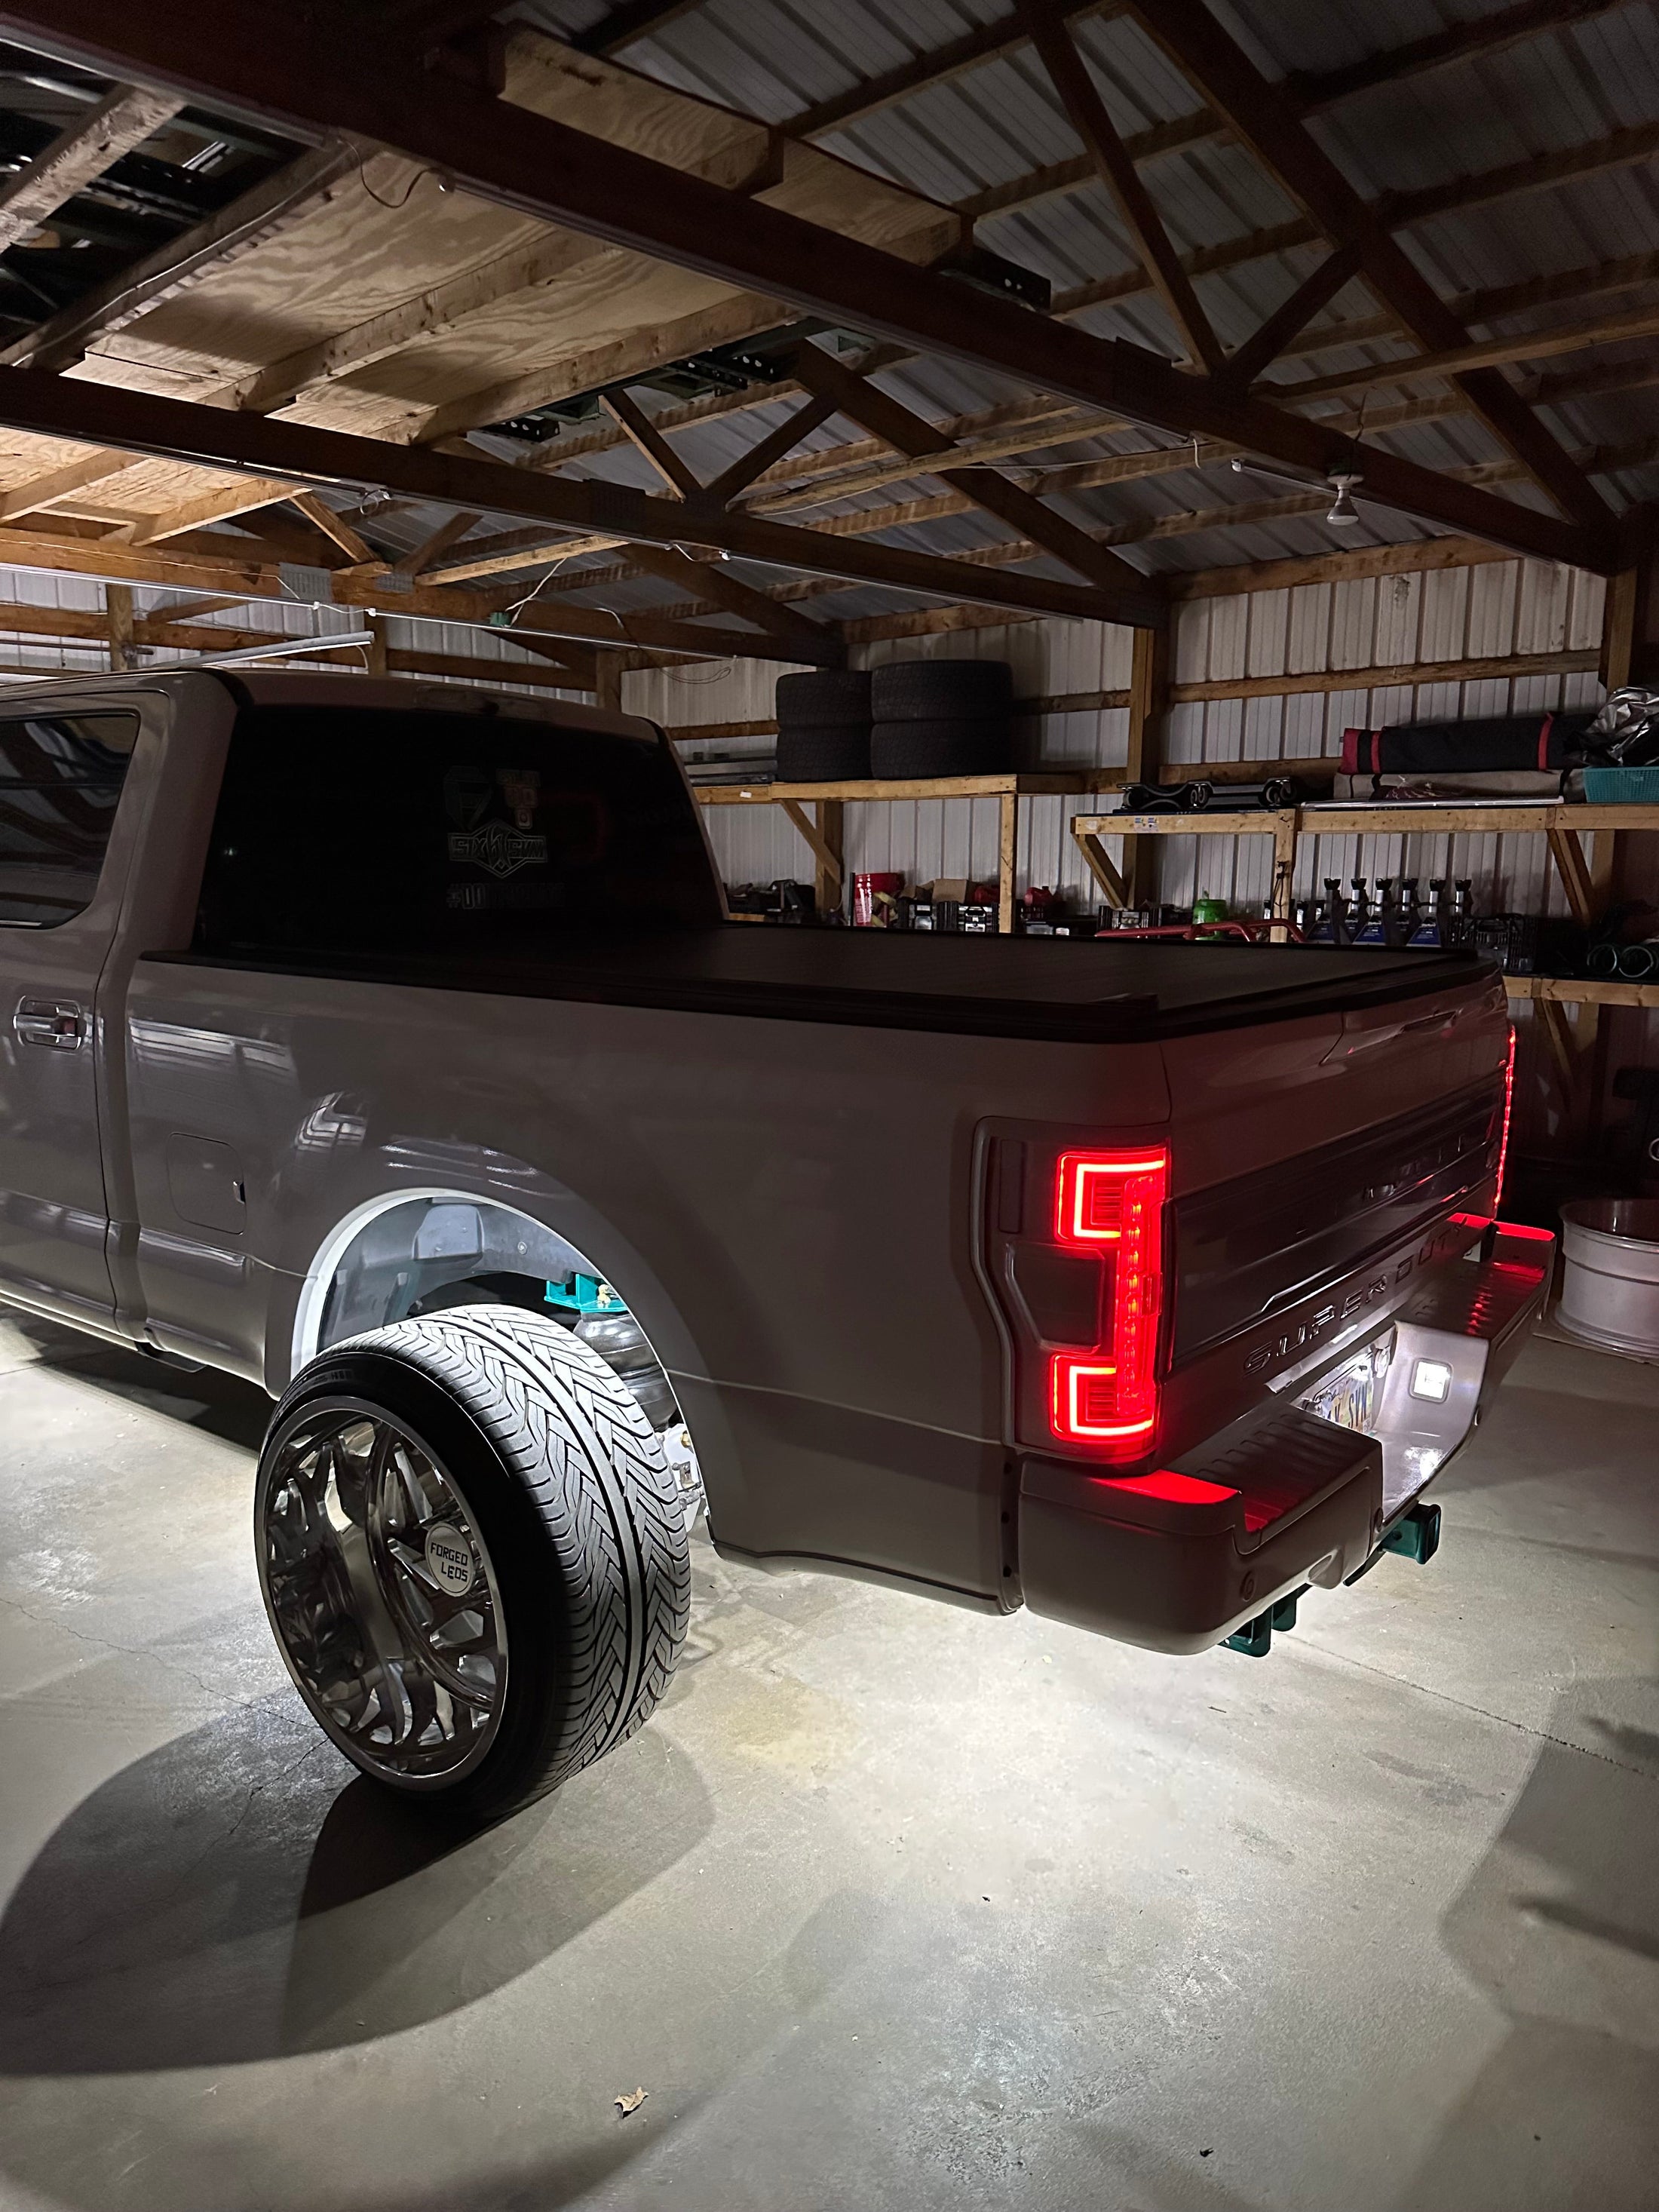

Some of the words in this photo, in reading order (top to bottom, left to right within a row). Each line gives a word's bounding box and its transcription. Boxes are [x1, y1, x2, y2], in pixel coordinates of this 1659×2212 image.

[1243, 1274, 1388, 1378] SUPER
[430, 1542, 468, 1566] FORGED
[441, 1561, 468, 1582] LEDS
